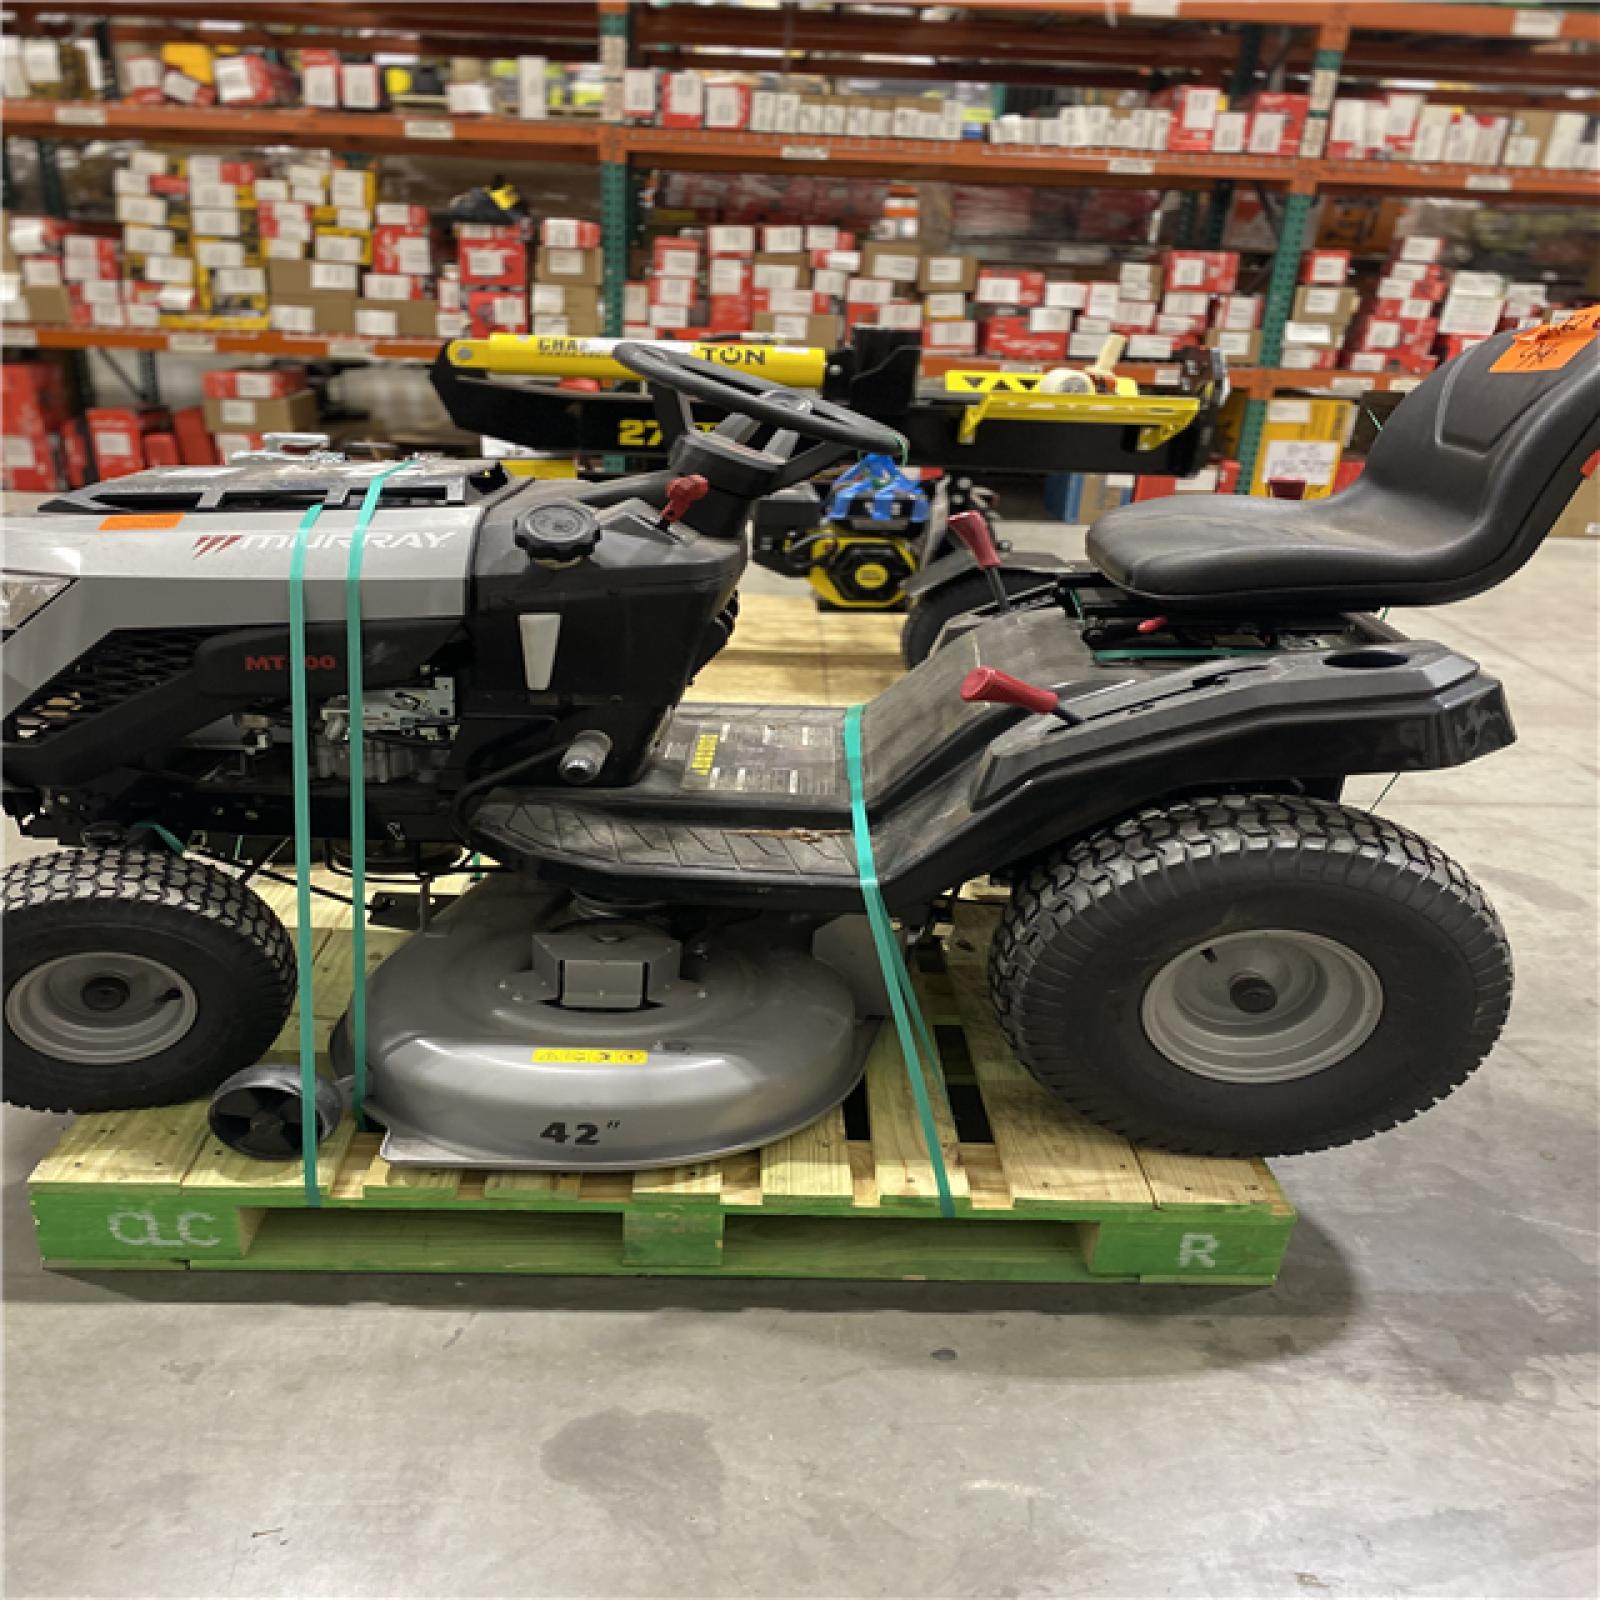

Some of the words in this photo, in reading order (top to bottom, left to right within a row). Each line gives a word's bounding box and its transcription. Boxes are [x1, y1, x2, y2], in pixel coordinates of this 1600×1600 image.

[618, 419, 664, 446] 27
[245, 655, 336, 671] MT00
[539, 1120, 621, 1146] 42"
[1177, 1232, 1220, 1268] R
